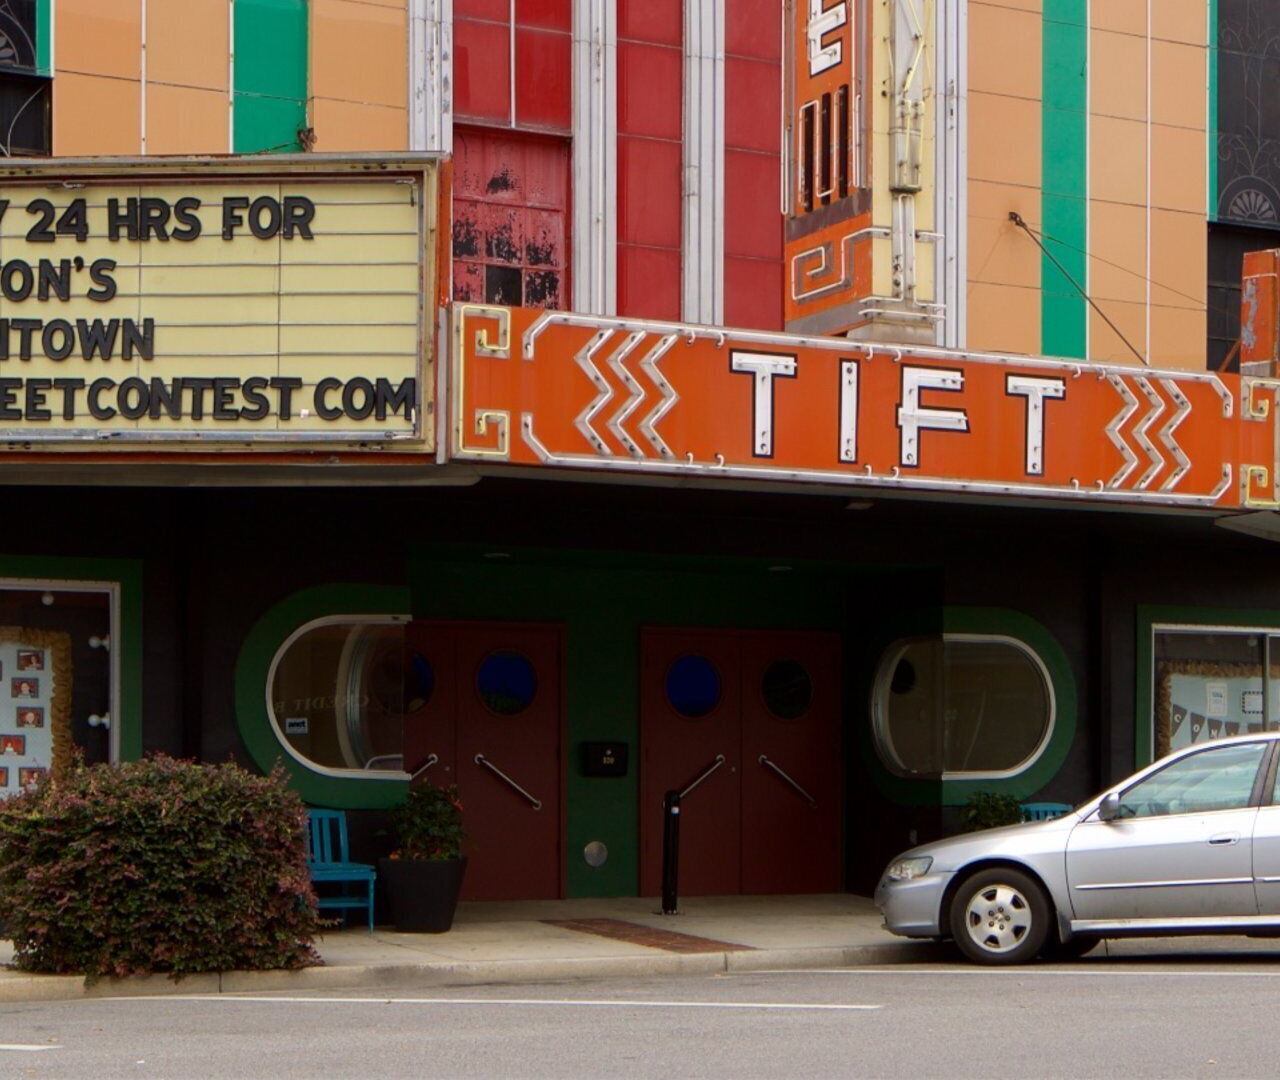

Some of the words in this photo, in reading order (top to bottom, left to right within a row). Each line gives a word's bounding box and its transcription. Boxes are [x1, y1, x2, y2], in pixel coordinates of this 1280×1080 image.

[25, 198, 89, 241] 24
[107, 197, 202, 241] HRS
[222, 196, 316, 240] FOR
[729, 348, 1067, 476] TIFT
